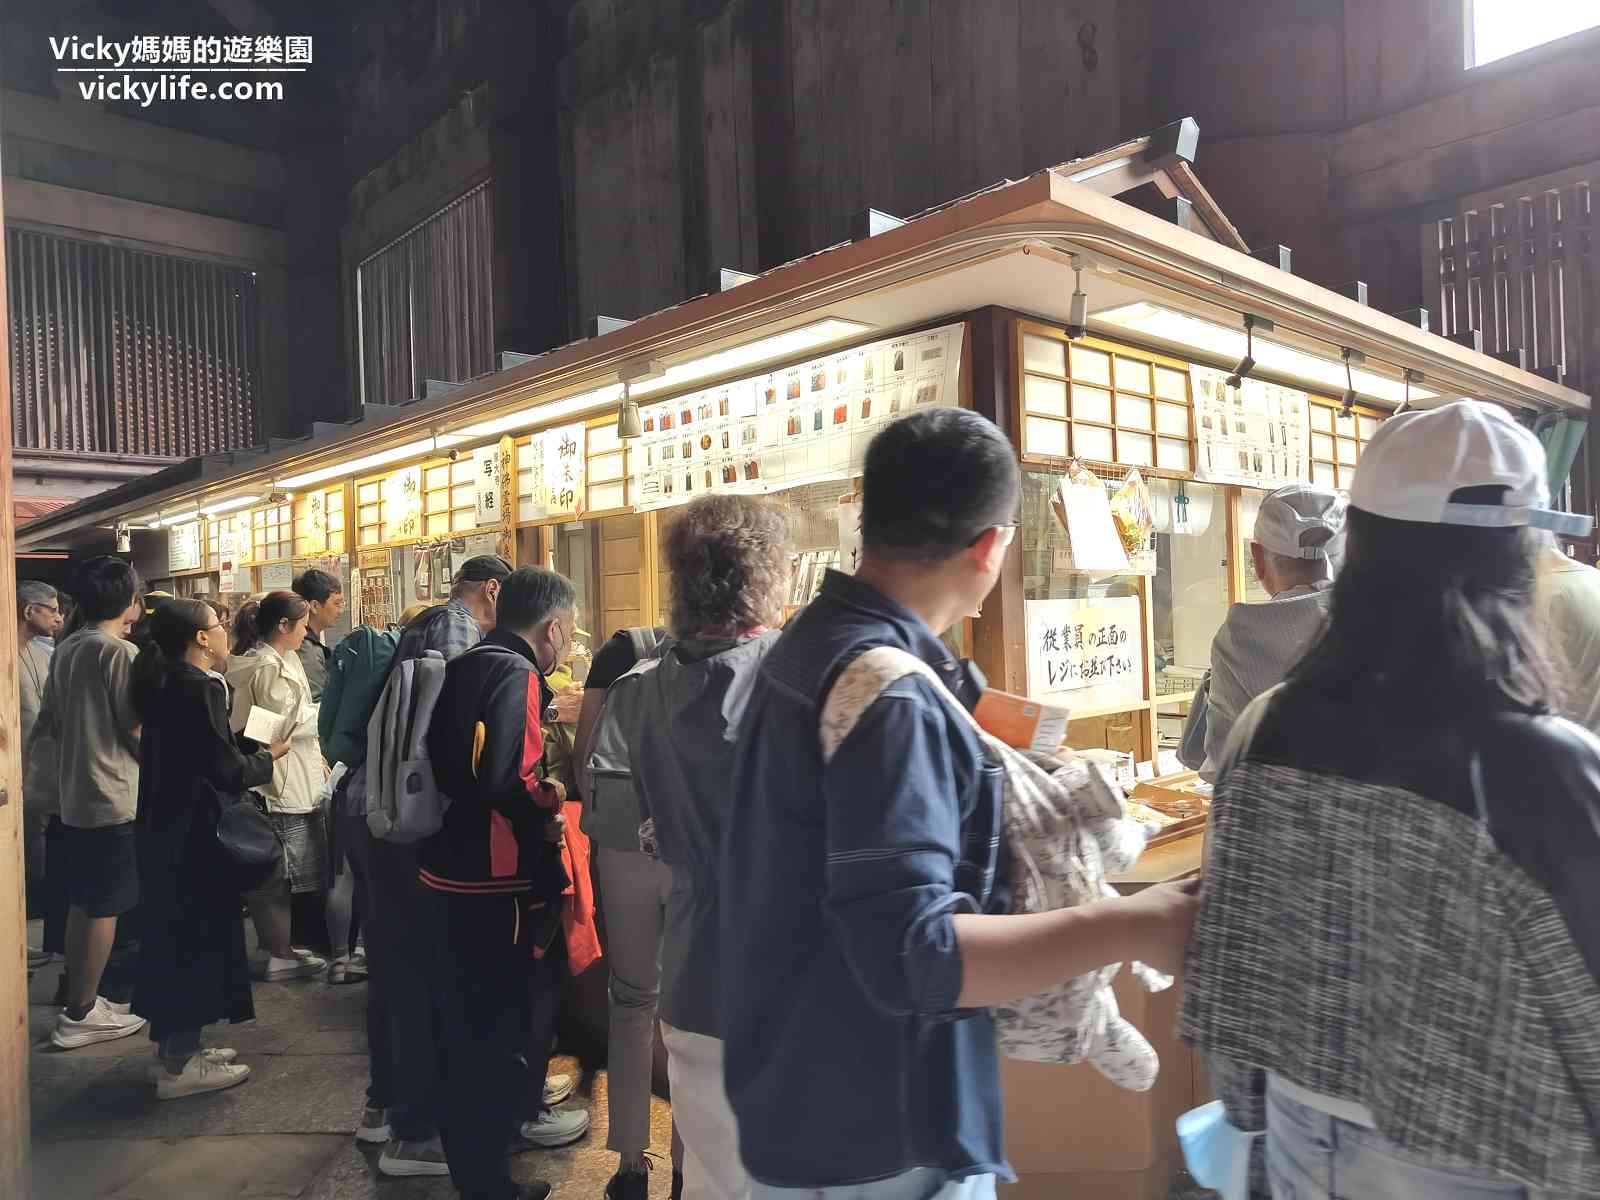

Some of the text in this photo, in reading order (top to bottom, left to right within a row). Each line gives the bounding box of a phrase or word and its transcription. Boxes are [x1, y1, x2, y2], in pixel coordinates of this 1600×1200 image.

[483, 459, 494, 510] 写経
[1042, 624, 1128, 653] 従業員の正面の
[1048, 654, 1132, 685] レジにお並び下さい
